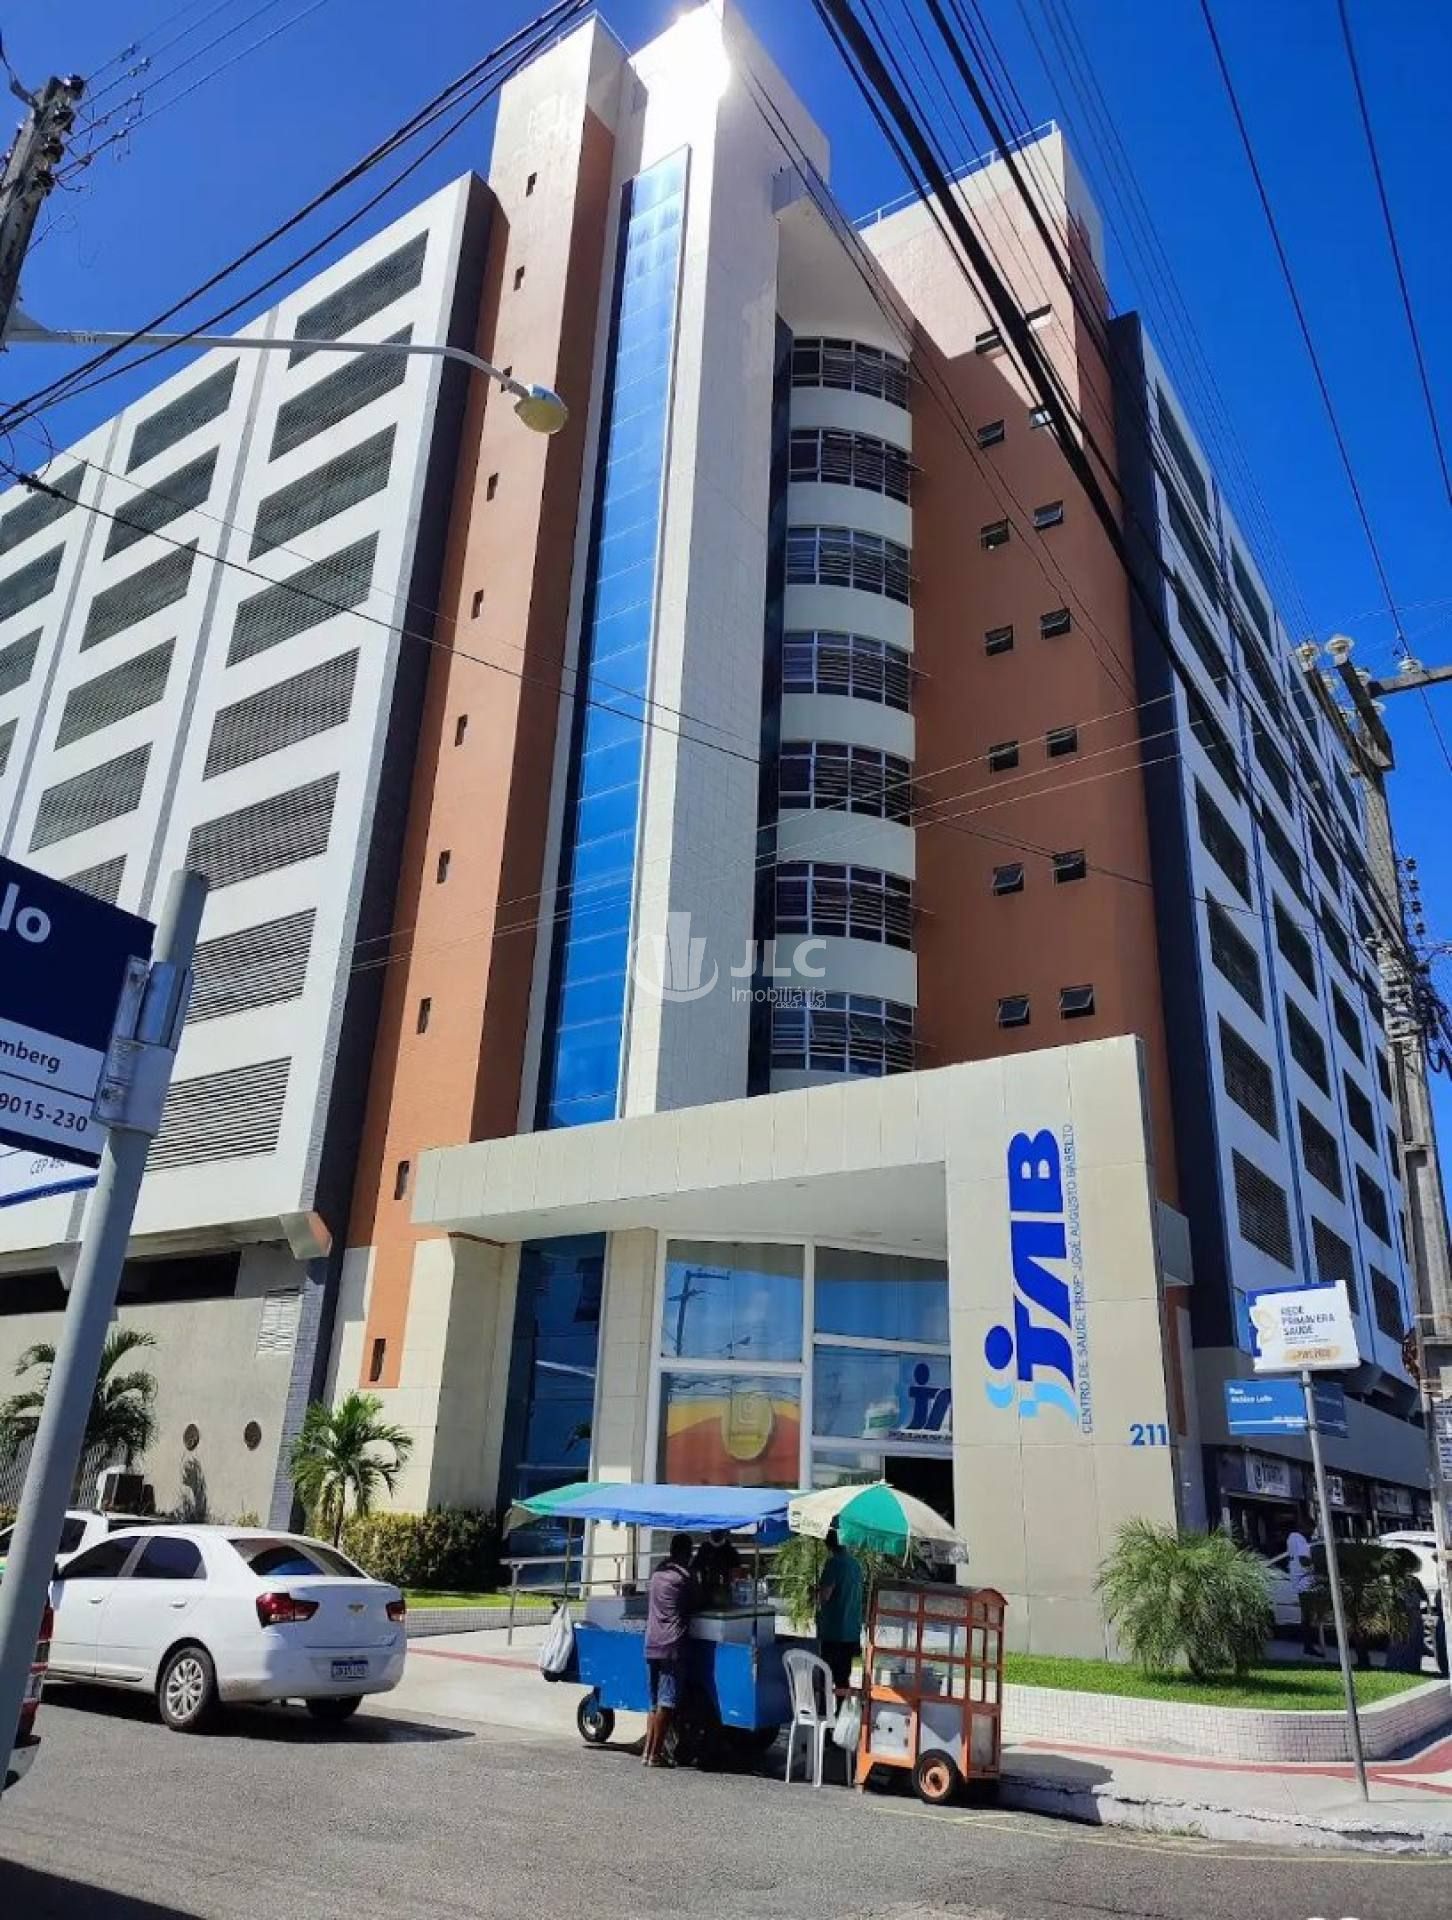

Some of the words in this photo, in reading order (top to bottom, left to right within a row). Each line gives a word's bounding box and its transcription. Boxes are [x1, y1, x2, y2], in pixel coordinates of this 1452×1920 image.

[0, 1039, 61, 1073] mberg
[0, 1092, 88, 1132] 9015-230
[1062, 1124, 1076, 1177] BARRETO
[1066, 1181, 1081, 1237] AUGUSTO
[1068, 1240, 1083, 1271] JOSÉ
[1281, 1313, 1336, 1326] PRIMAVERA
[1078, 1360, 1089, 1378] DE
[1079, 1381, 1093, 1434] CENTRO
[1129, 1423, 1168, 1446] 211
